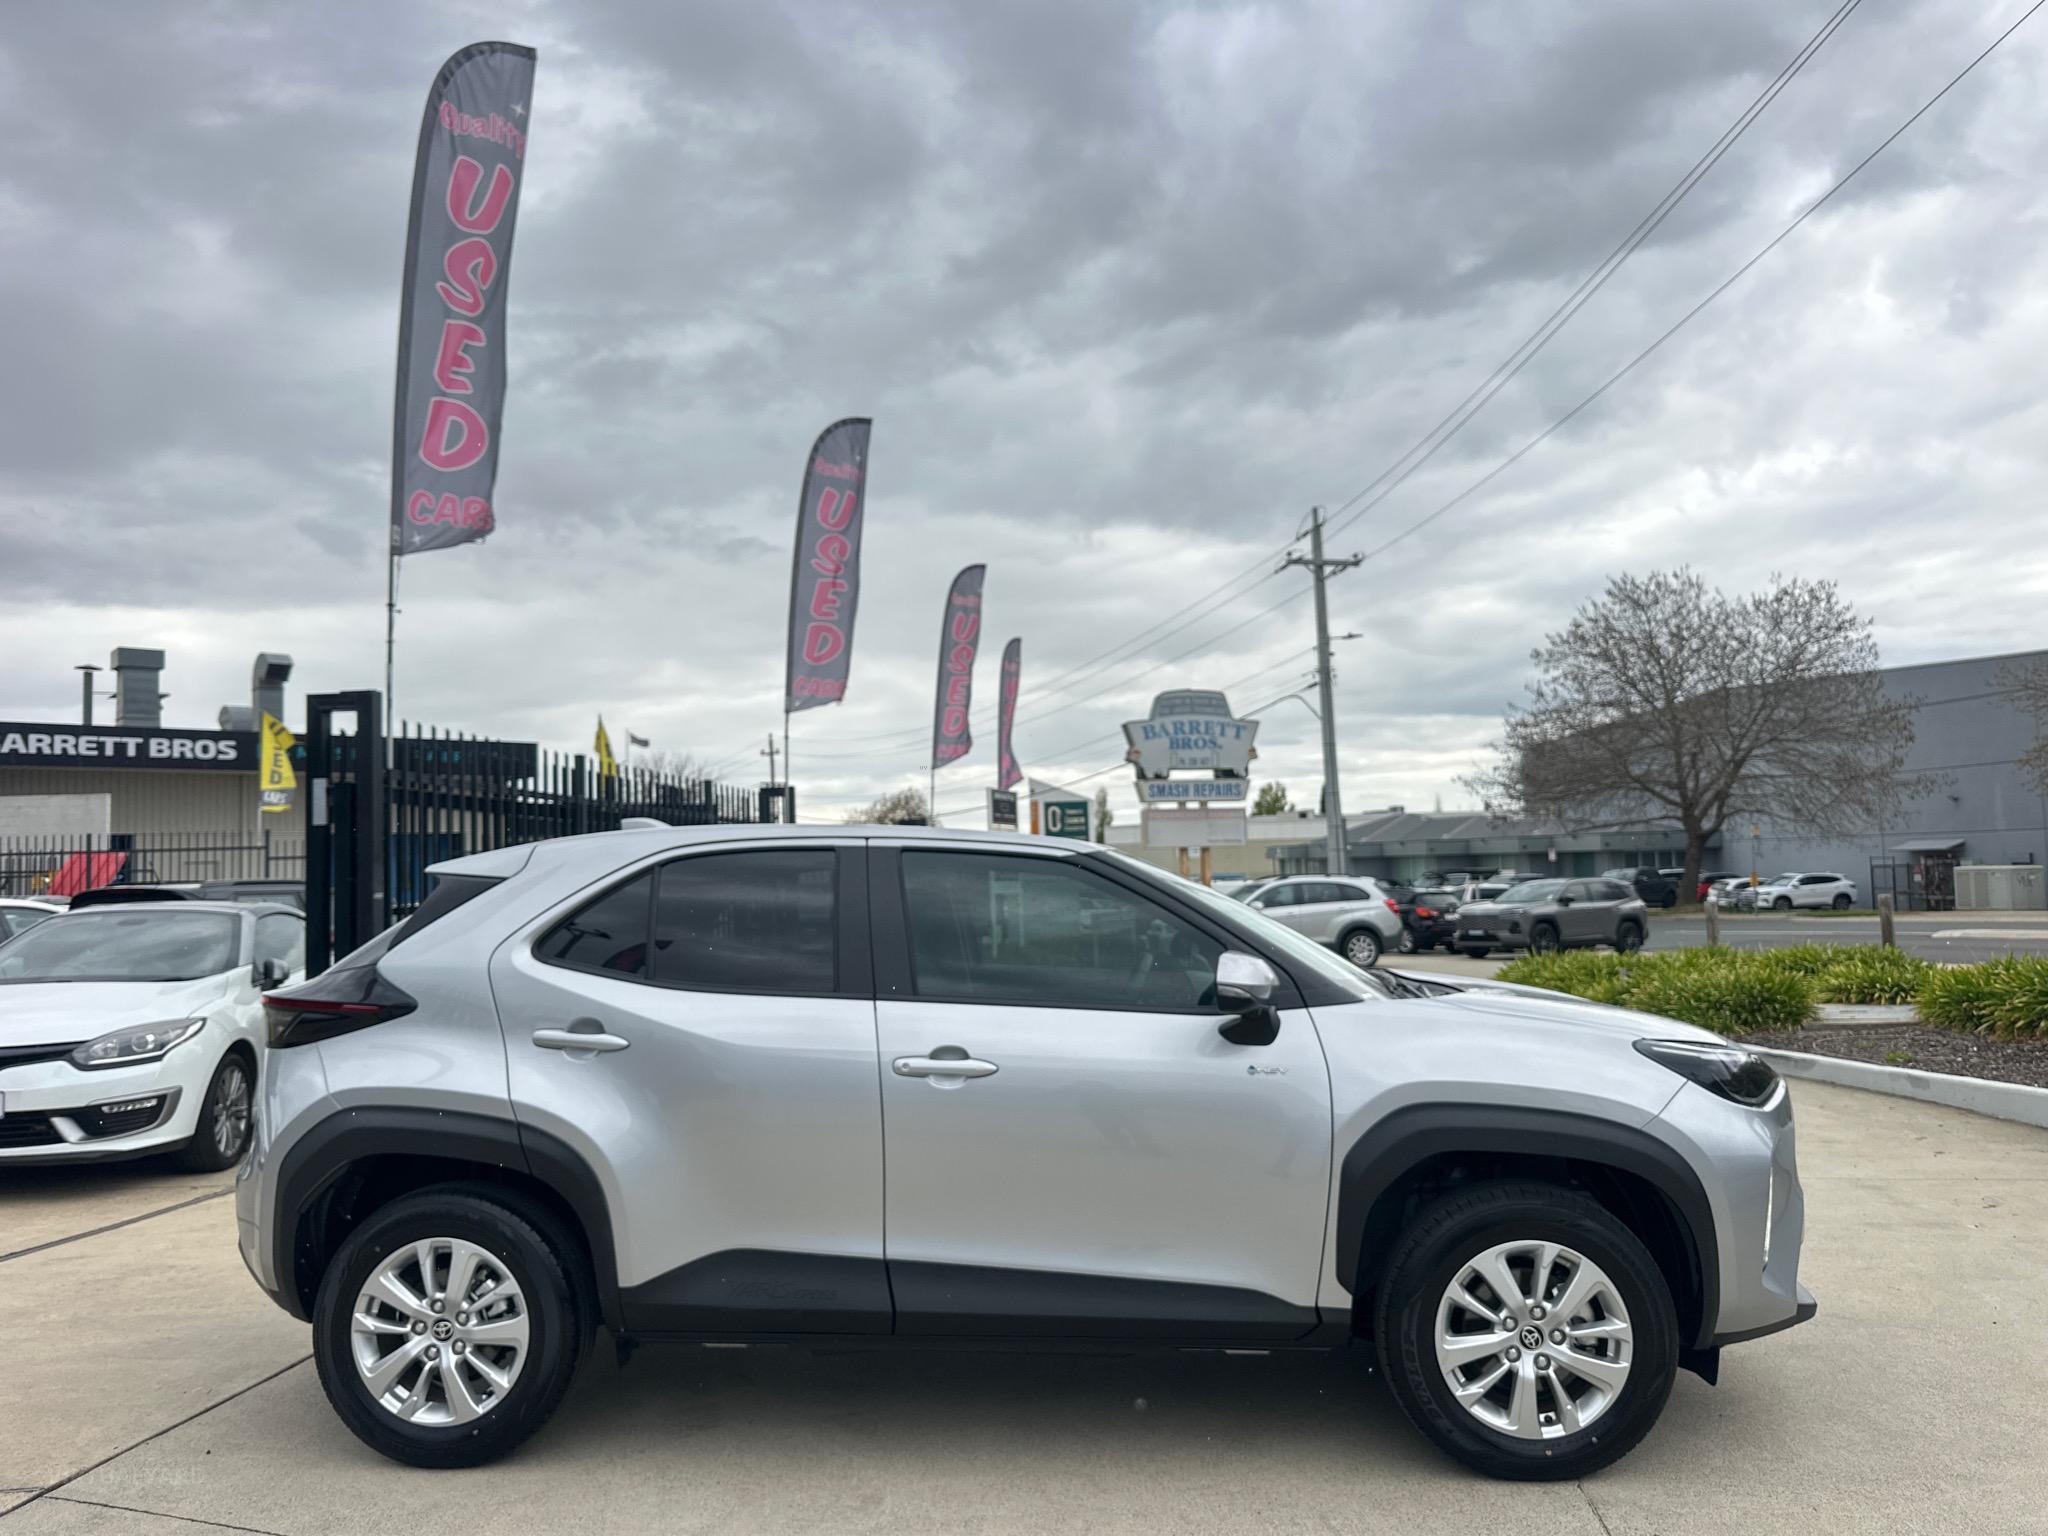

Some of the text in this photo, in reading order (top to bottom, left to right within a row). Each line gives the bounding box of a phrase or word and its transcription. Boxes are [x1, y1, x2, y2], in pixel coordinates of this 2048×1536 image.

[419, 154, 514, 472] USED
[803, 487, 857, 666] USED
[943, 611, 979, 738] USED
[0, 733, 144, 758] ARRETT
[149, 737, 238, 761] BROS
[1142, 720, 1247, 741] BARRETT
[1148, 783, 1243, 798] SMASH REPAIRS
